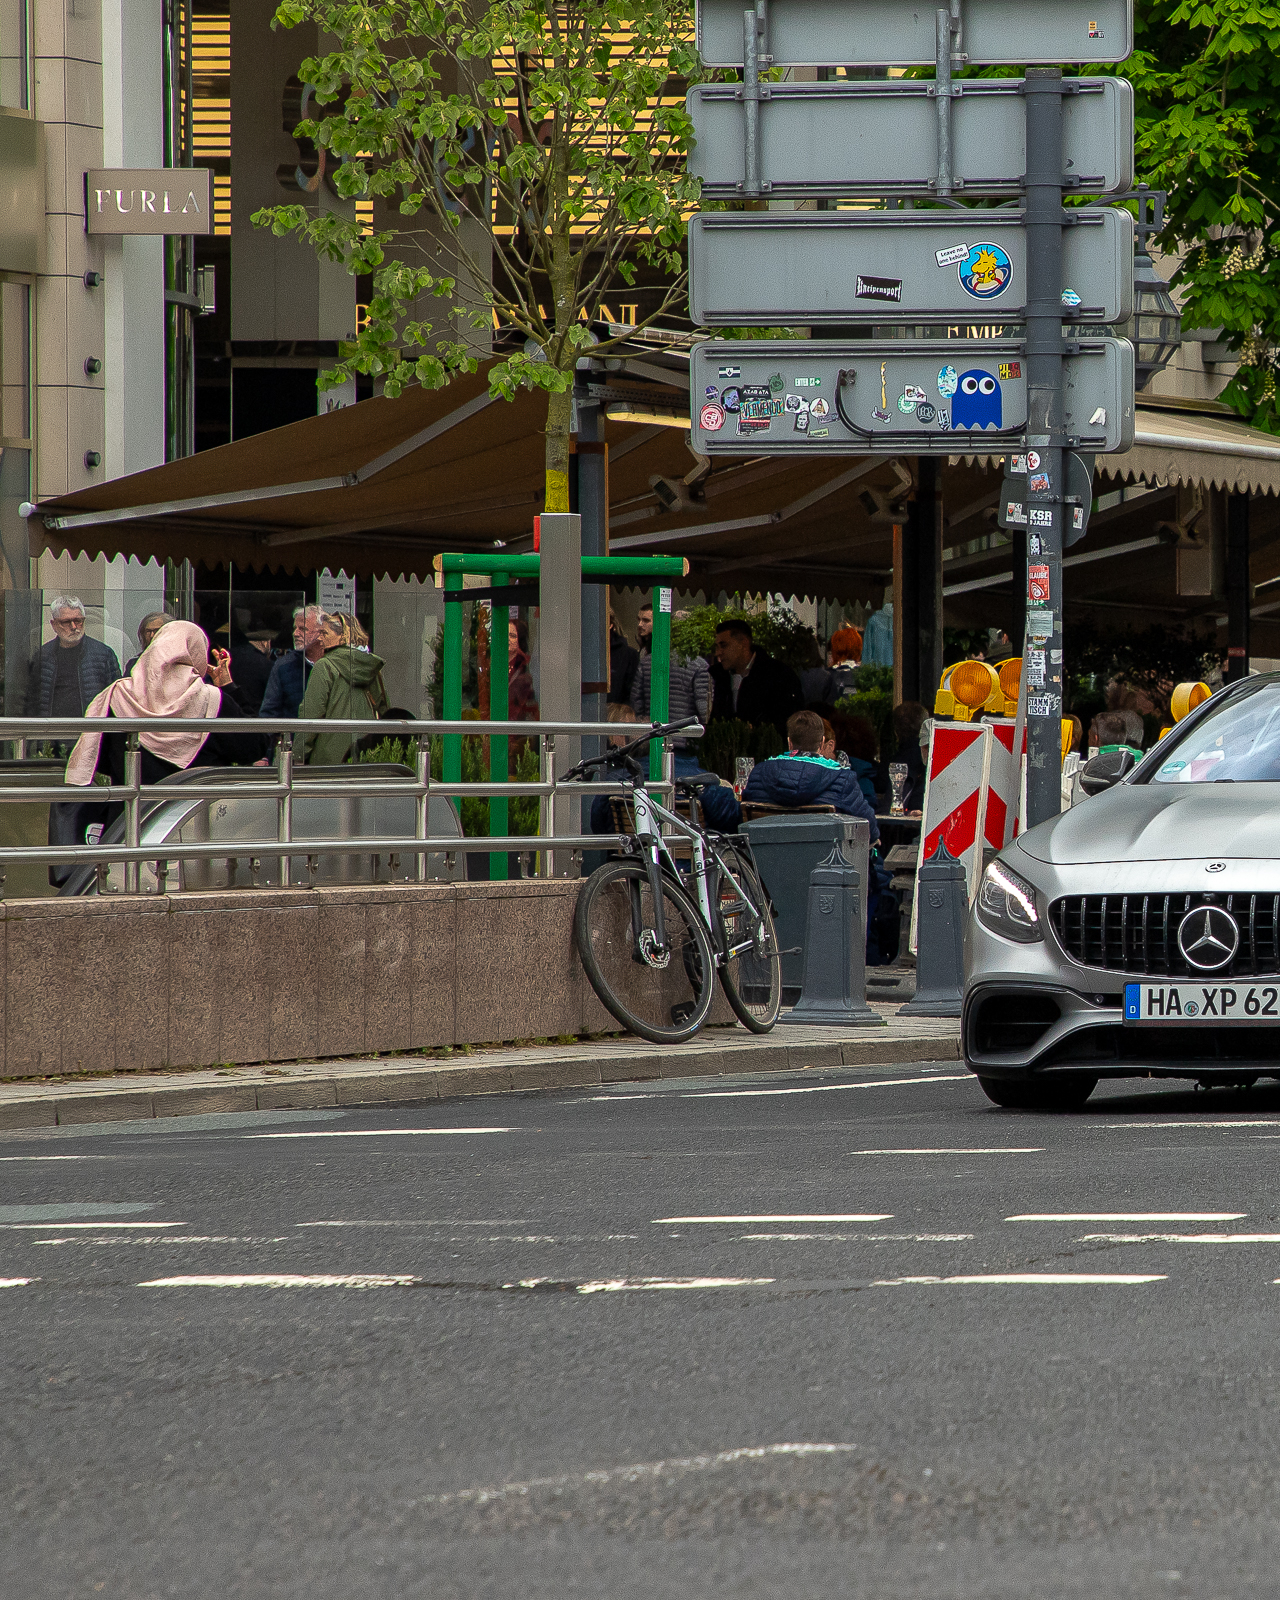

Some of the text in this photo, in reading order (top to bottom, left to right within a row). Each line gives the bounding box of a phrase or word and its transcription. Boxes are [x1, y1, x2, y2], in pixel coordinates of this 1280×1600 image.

[95, 189, 200, 213] FURLA
[1029, 509, 1052, 521] KSR
[1029, 698, 1048, 706] STAMM
[1030, 706, 1046, 714] TISCH
[1147, 988, 1182, 1016] HA
[1201, 988, 1237, 1016] XP
[1244, 987, 1279, 1016] 62
